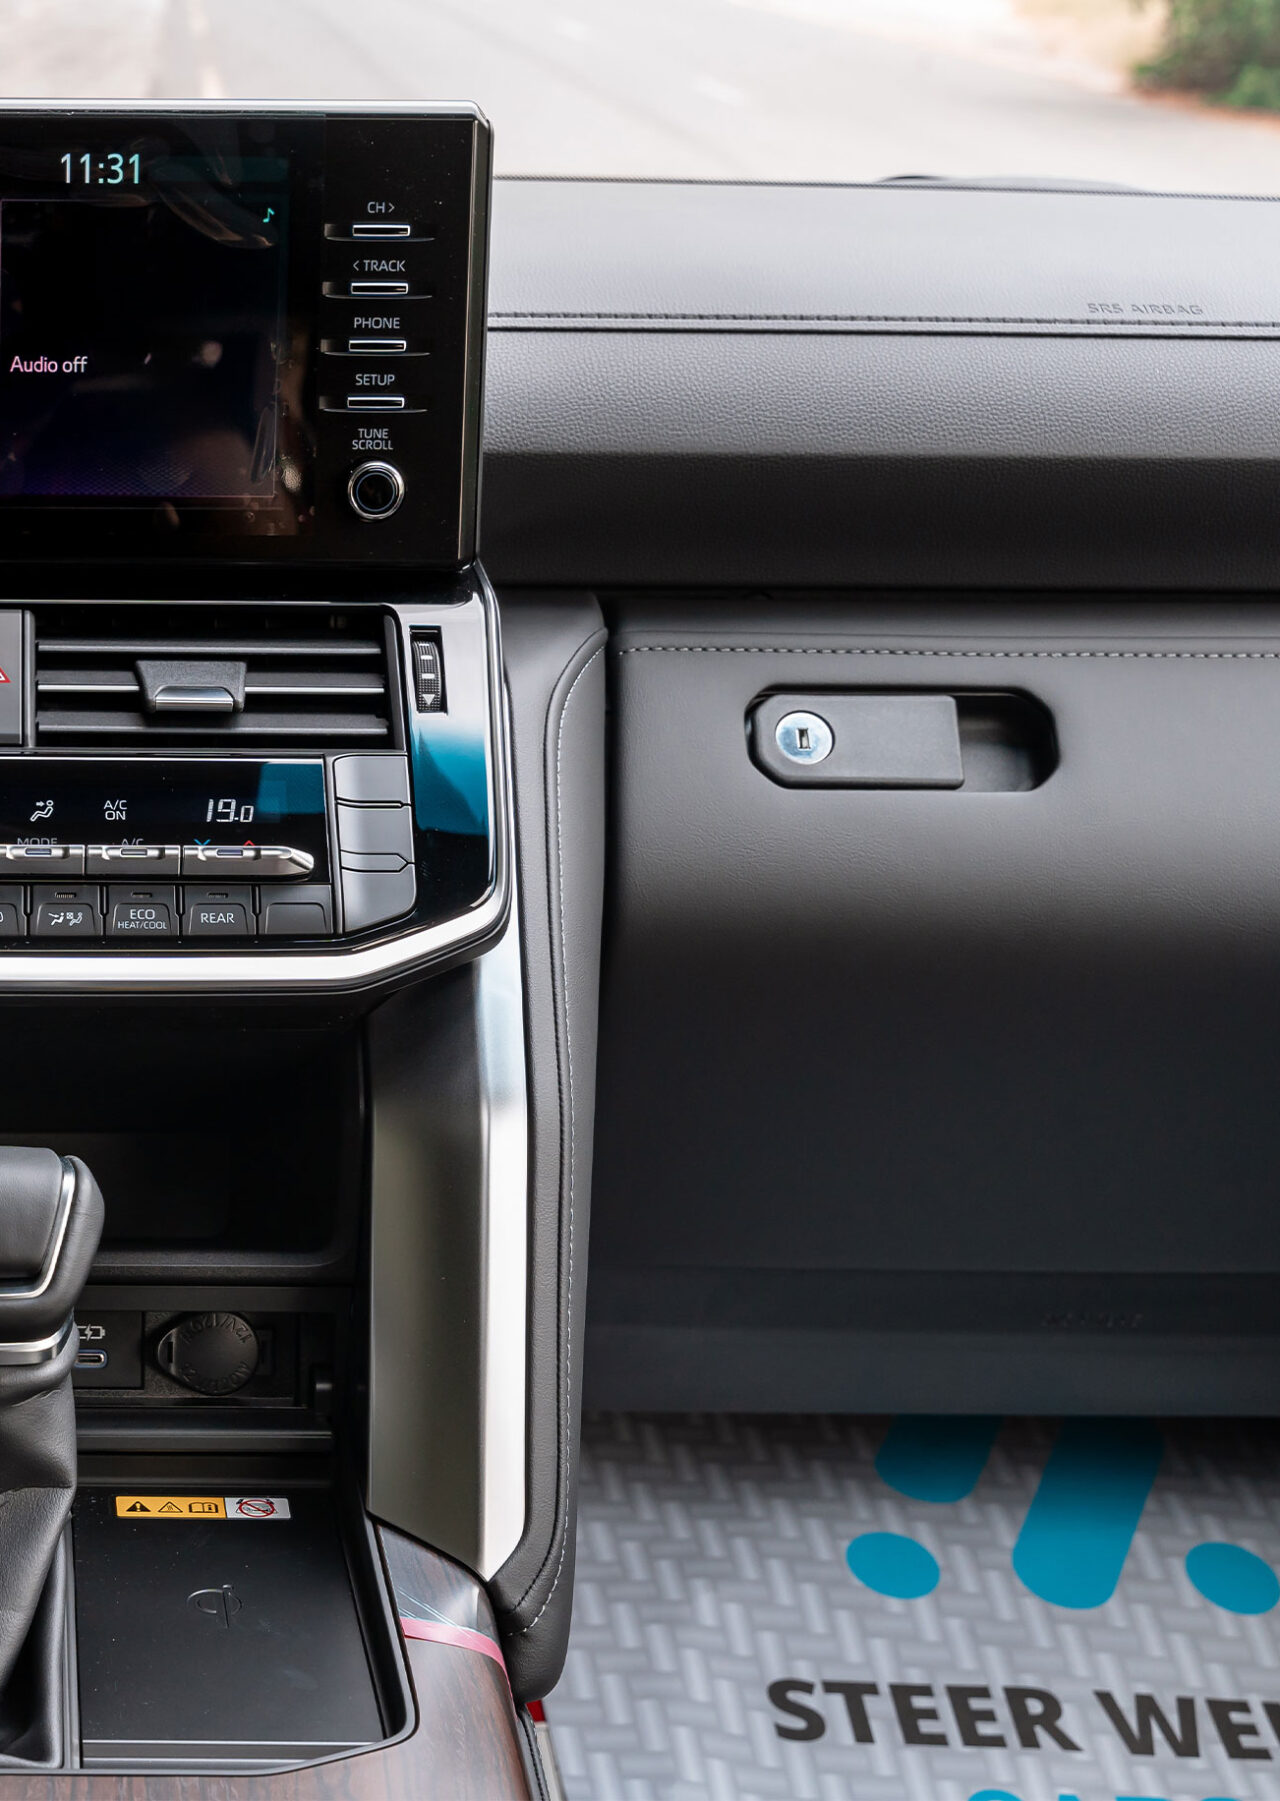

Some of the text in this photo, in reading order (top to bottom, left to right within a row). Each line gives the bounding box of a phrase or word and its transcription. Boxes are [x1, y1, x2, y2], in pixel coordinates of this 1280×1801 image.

[60, 153, 140, 184] 11:31
[363, 260, 406, 272] TRACK
[1086, 303, 1204, 316] SRS AIRBAG
[353, 317, 400, 329] PHONE
[10, 355, 88, 373] Audio off
[355, 374, 396, 386] SETUP
[358, 428, 389, 439] TUNE
[352, 439, 394, 450] SCROLL
[103, 799, 128, 811] A/C
[206, 798, 254, 823] 19.0
[104, 810, 127, 821] ON
[129, 908, 155, 921] ECO
[200, 911, 235, 924] REAR
[117, 920, 167, 930] HEAT/COOL
[767, 1677, 1084, 1752] STEER
